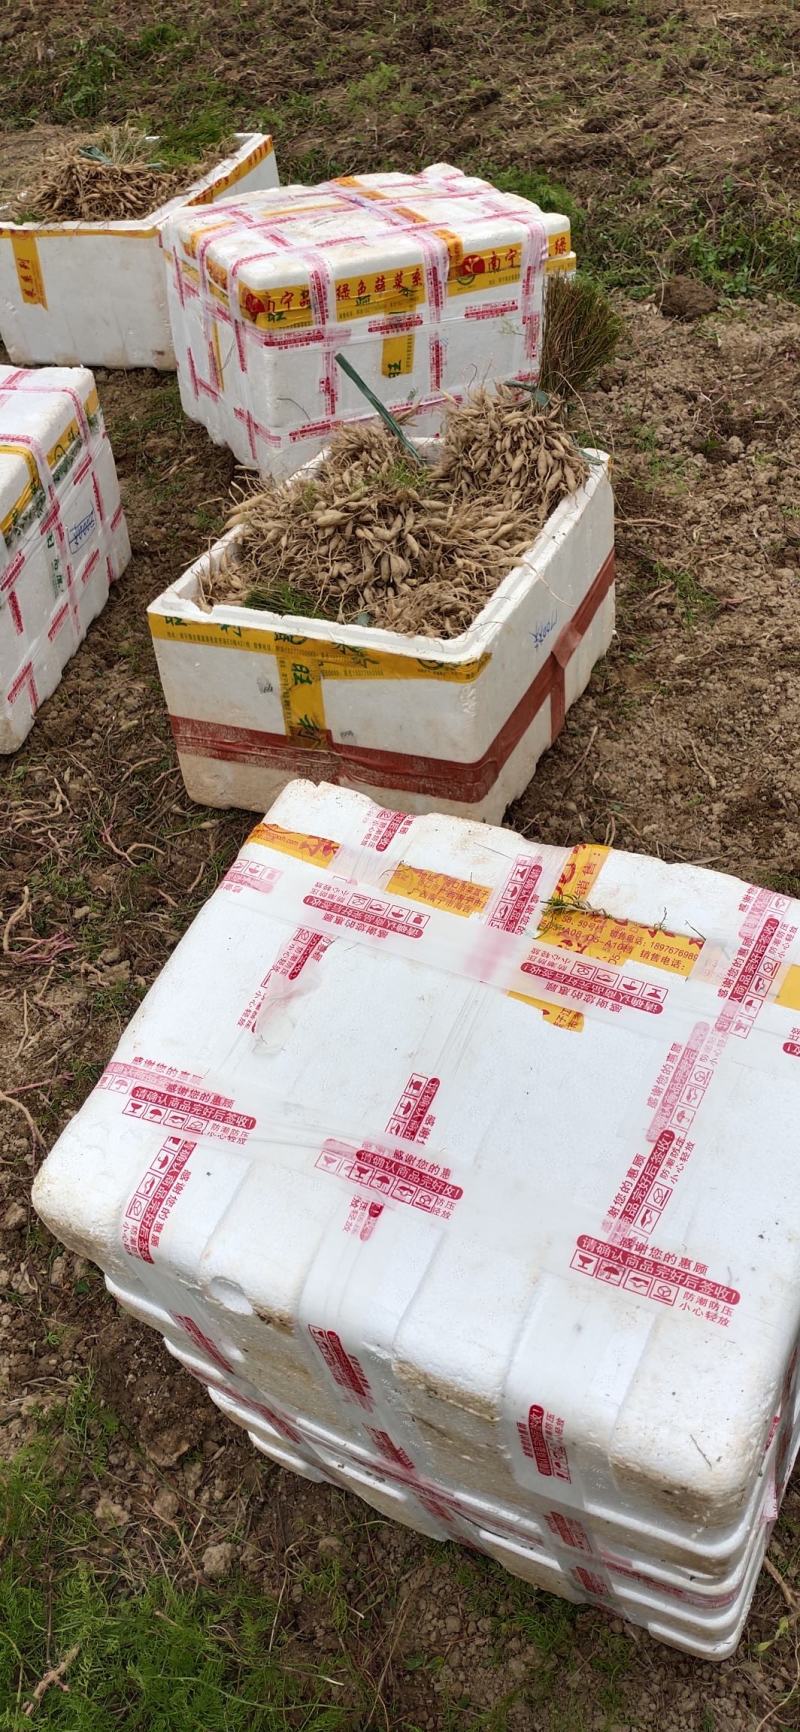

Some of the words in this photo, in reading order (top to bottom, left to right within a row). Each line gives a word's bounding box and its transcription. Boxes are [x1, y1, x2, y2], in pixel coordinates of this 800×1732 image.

[488, 249, 517, 272] 南宁
[545, 982, 622, 1013] 感谢您的惠顾
[131, 1086, 257, 1130] 请确认商品完好后签收!
[165, 1083, 236, 1109] 感谢您的惠顾
[660, 1135, 686, 1181] 防潮防压
[670, 1141, 696, 1185] 小心轻放
[577, 1234, 741, 1305] 请确认商品完好后签收!
[619, 1236, 710, 1276] 感谢您的惠顾
[679, 1301, 731, 1328] 小心轻放
[682, 1290, 734, 1317] 防潮防压
